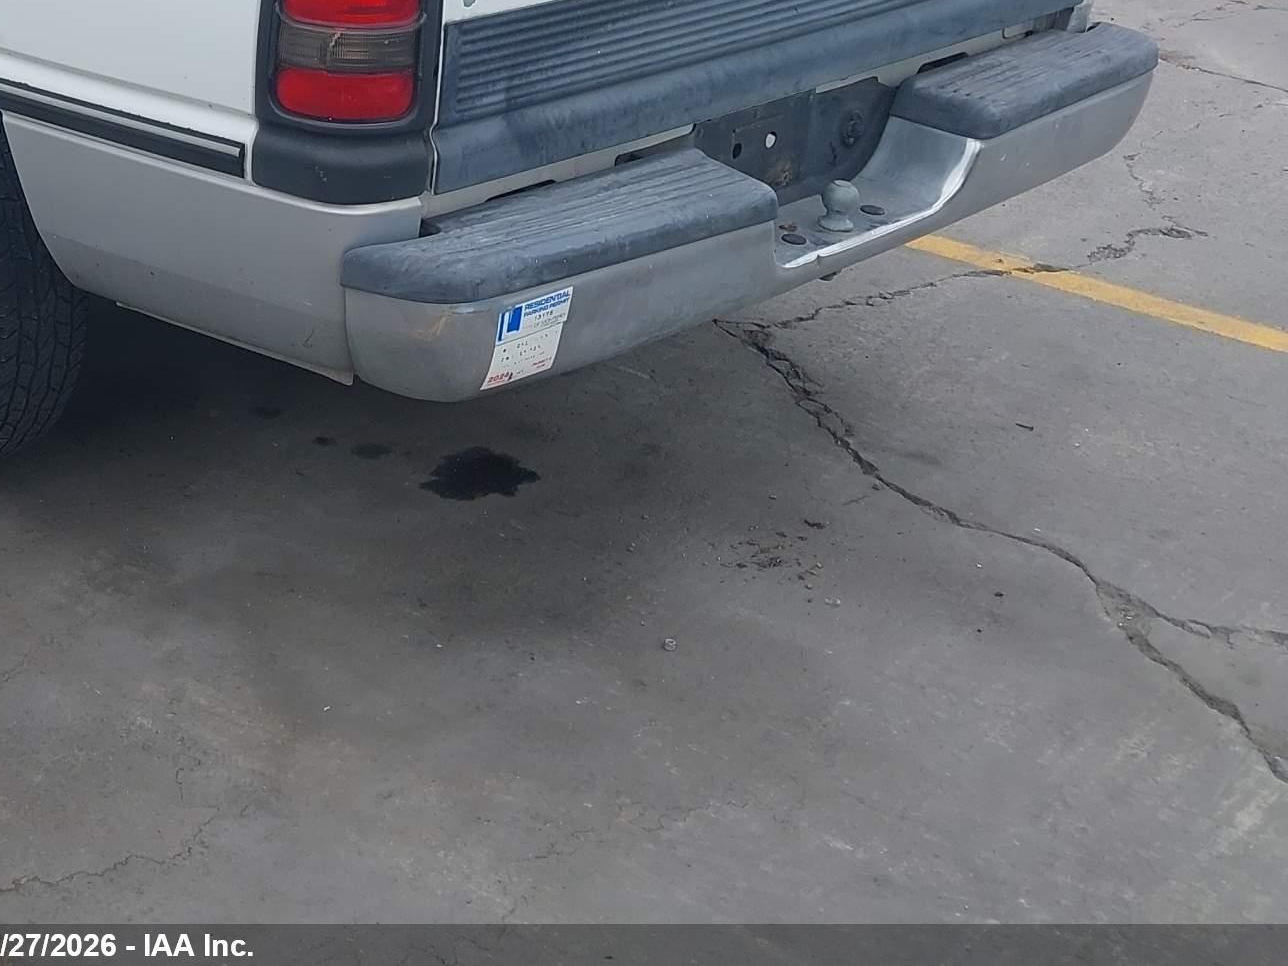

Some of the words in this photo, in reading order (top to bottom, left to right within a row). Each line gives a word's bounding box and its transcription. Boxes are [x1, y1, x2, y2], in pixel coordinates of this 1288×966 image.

[524, 290, 569, 311] RESIDENTIAL
[524, 305, 548, 317] PARKING
[549, 298, 569, 310] PERMIT
